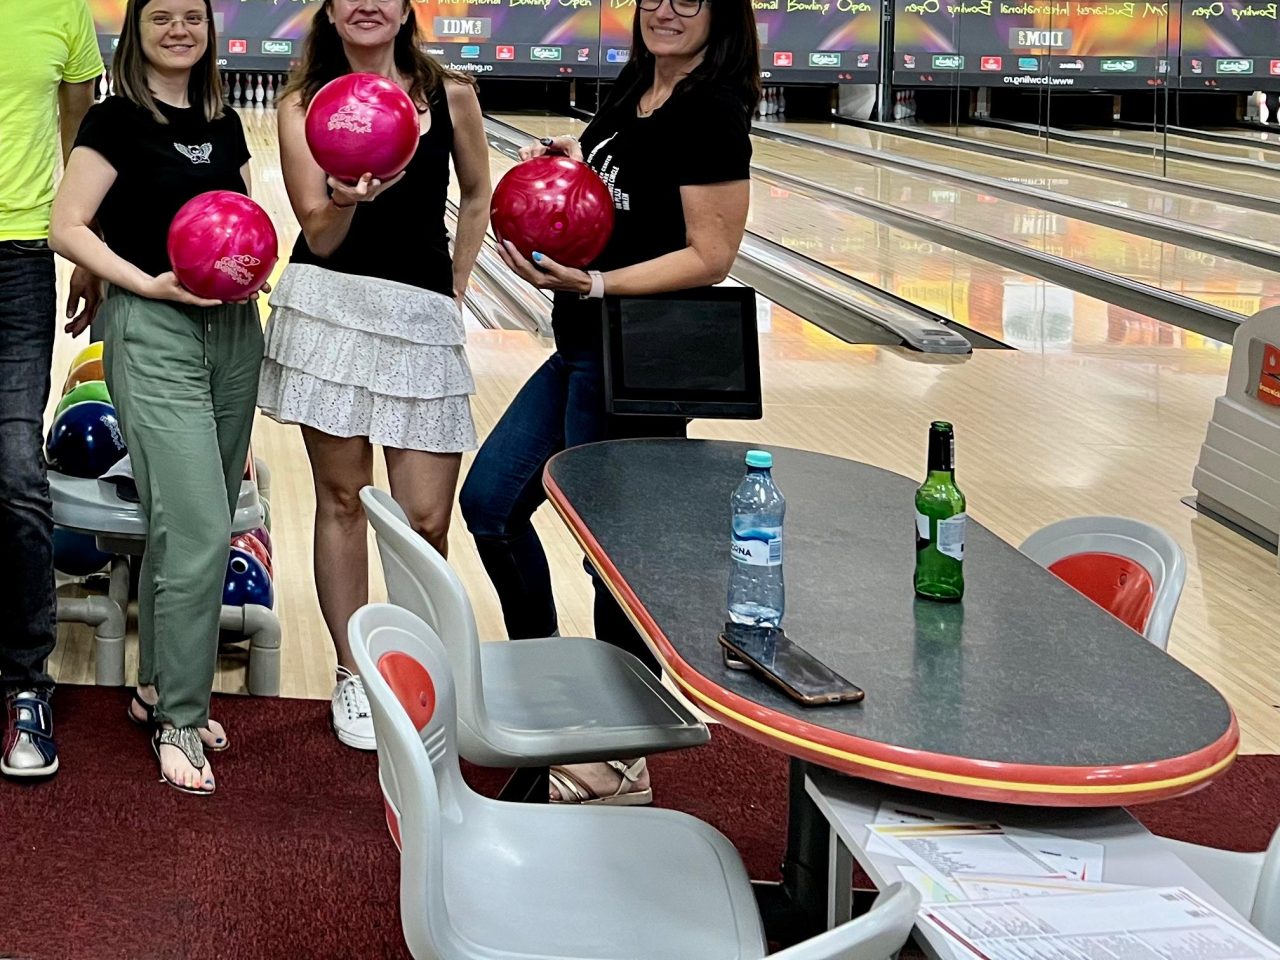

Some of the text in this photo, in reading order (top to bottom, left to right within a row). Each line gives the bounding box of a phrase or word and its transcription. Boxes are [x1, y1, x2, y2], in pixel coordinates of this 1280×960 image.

[442, 19, 474, 34] IDM
[443, 62, 493, 73] w.bowling.ro
[730, 543, 752, 557] ORNA
